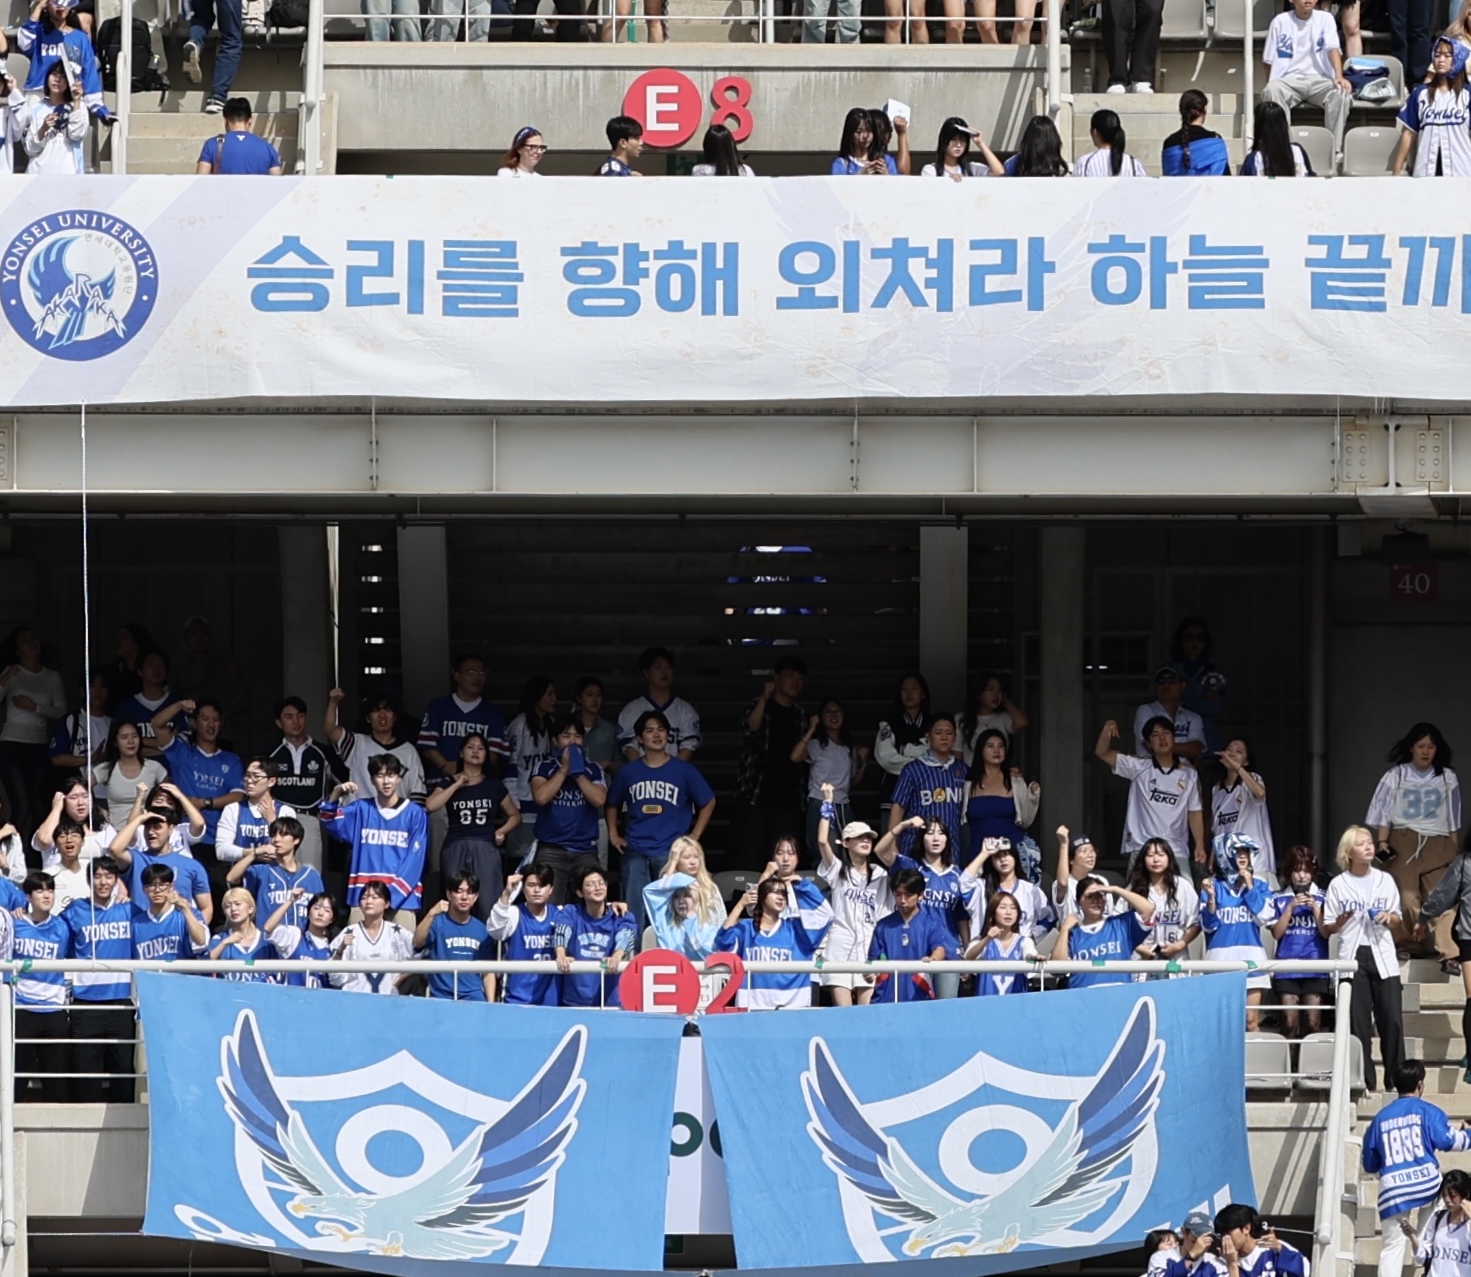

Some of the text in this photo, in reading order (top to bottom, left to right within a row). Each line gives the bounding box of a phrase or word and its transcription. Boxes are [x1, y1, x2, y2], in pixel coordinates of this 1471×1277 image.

[2, 213, 154, 283] YONSEI UNIVERSITY
[246, 236, 521, 318] 승리를
[561, 239, 741, 318] 향해
[775, 239, 1055, 313] 외쳐라
[1087, 232, 1267, 310] 하늘
[1396, 573, 1431, 594] 40
[278, 776, 316, 787] SCOTLAND
[453, 799, 491, 809] YONSEI
[630, 781, 678, 805] YONSEI
[1403, 789, 1442, 818] 32
[82, 921, 131, 942] YONSEI
